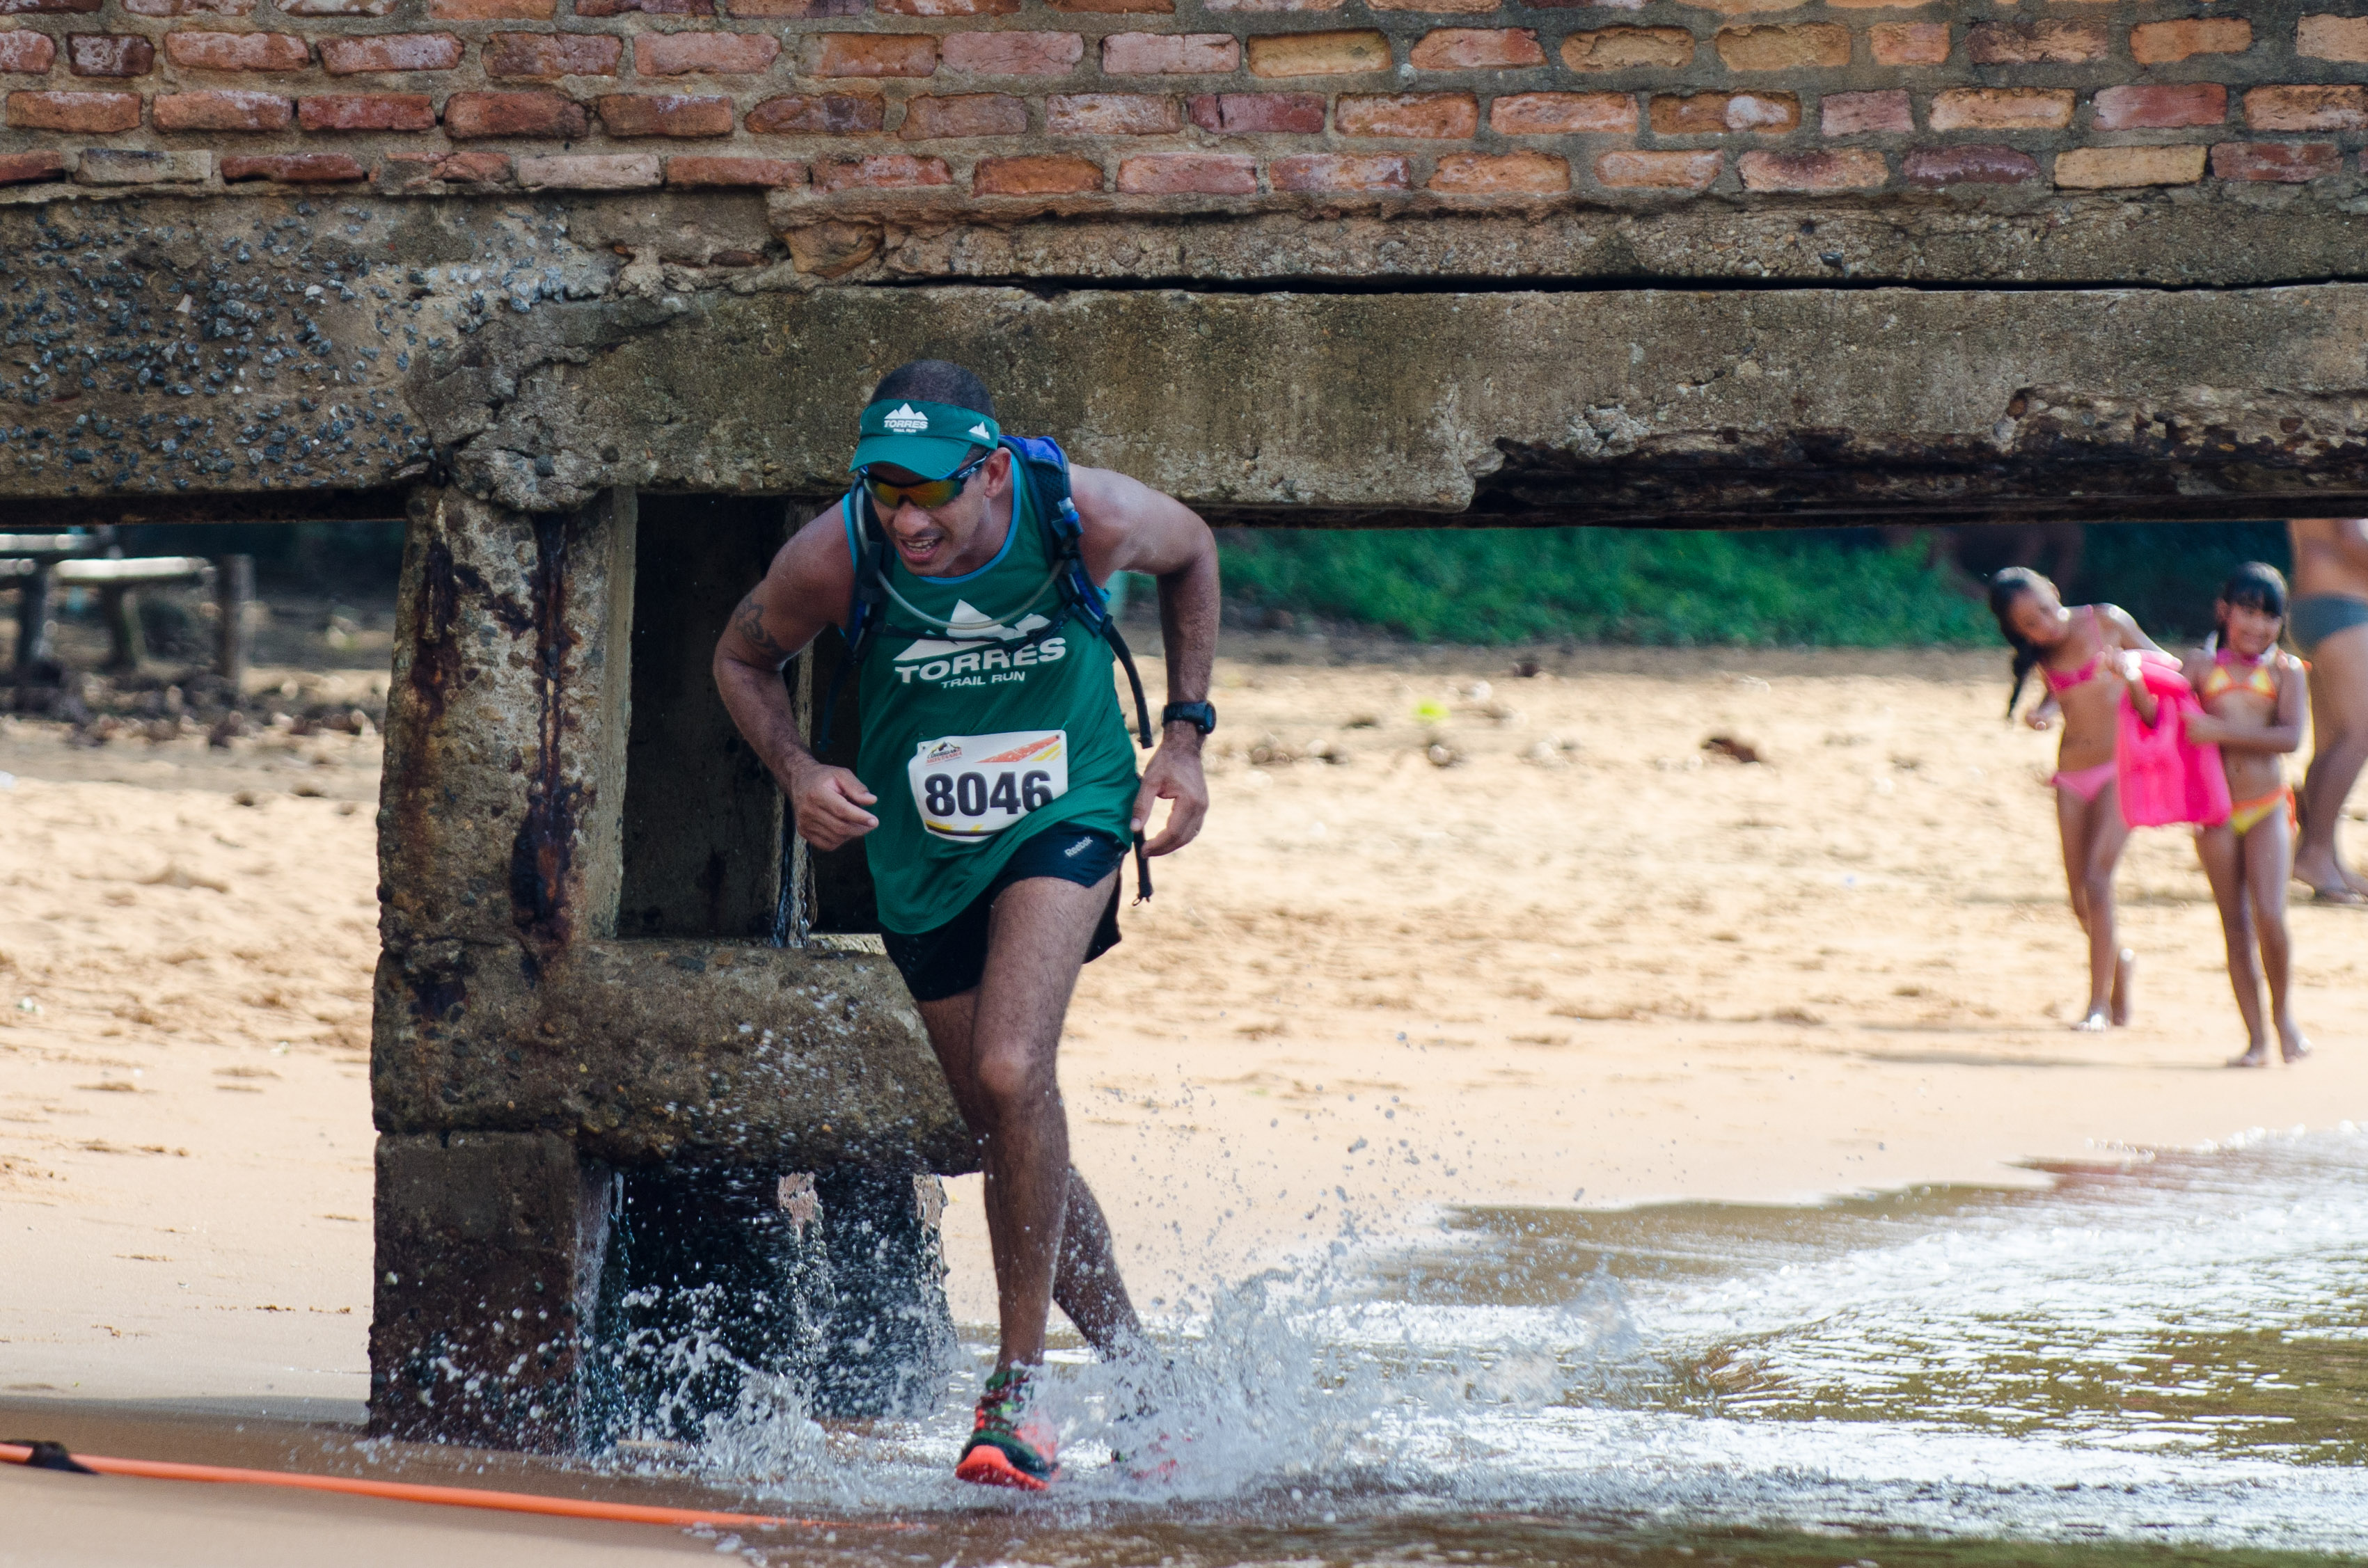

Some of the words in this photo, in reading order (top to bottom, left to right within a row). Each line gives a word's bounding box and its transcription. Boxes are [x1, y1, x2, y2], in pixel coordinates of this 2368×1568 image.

[884, 420, 929, 429] TORRES
[895, 637, 1066, 683] TORRES
[942, 675, 986, 688] TRAIL
[991, 671, 1025, 683] RUN
[924, 769, 1053, 816] 8046
[1064, 836, 1093, 857] Reebok
